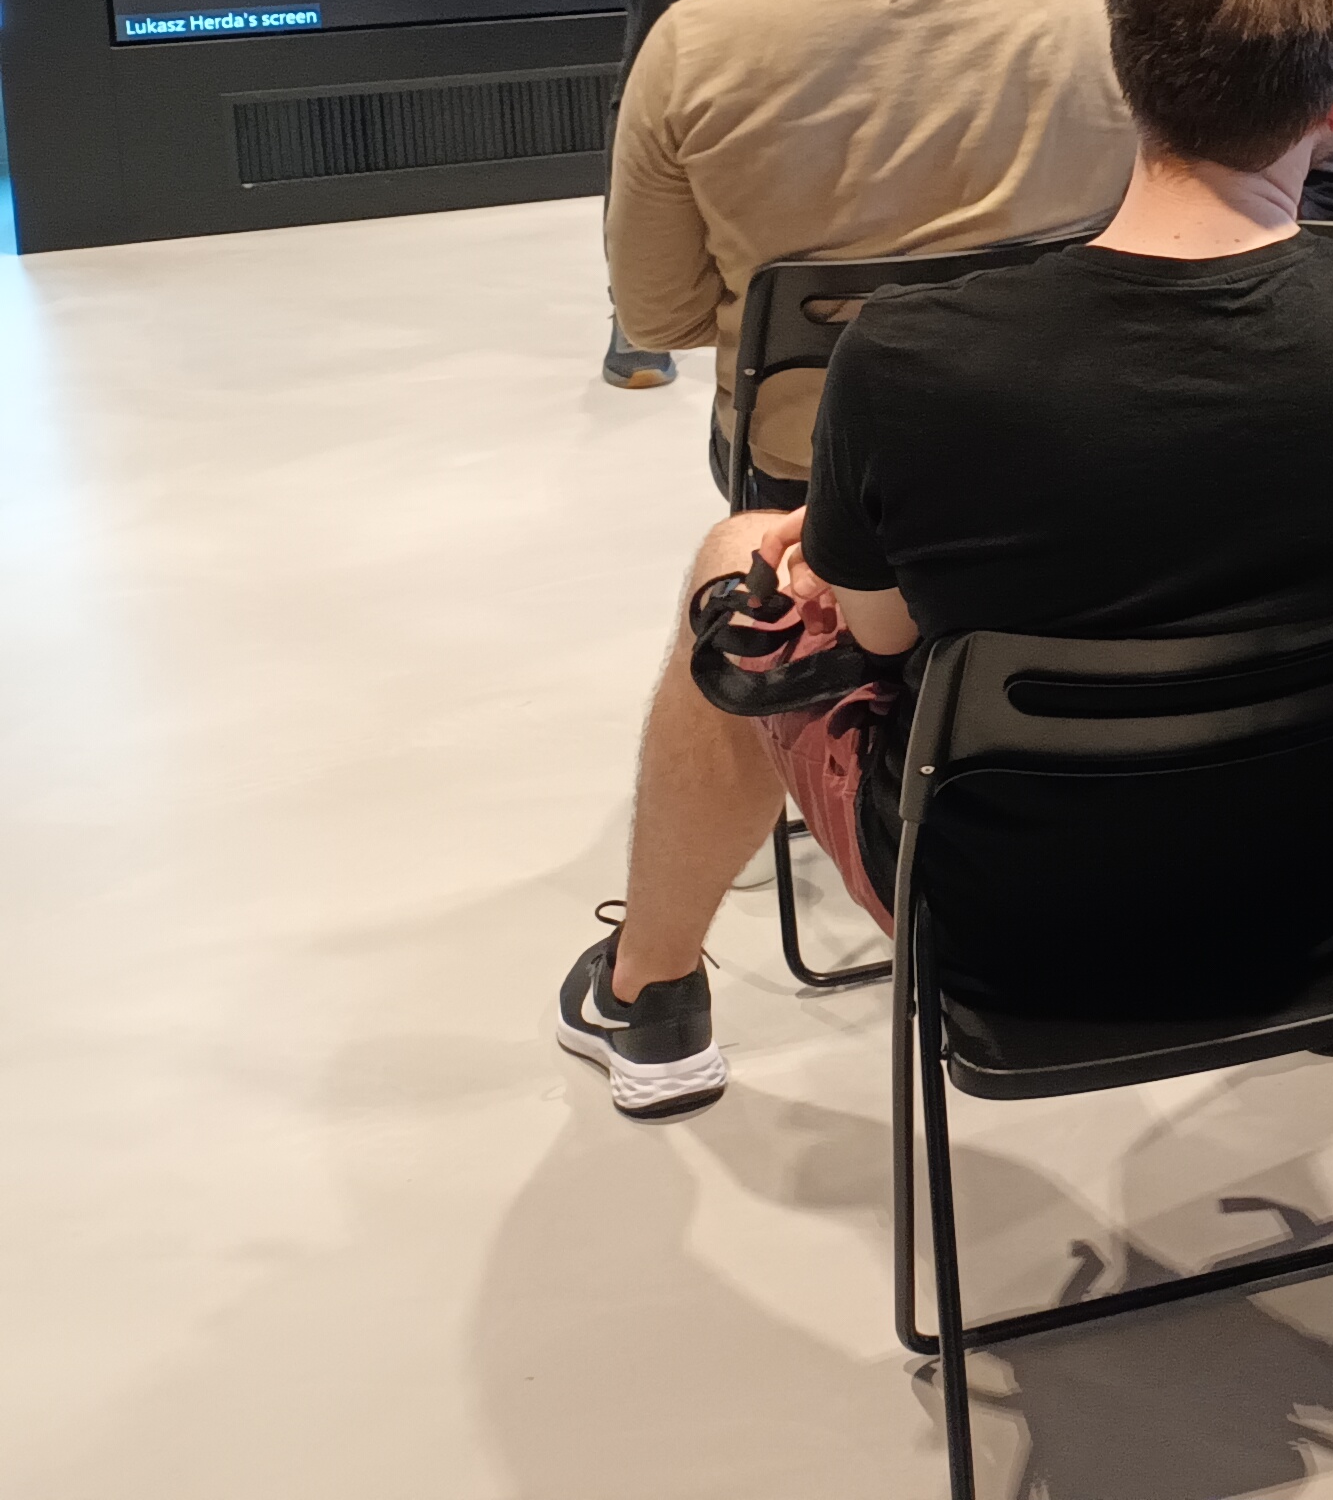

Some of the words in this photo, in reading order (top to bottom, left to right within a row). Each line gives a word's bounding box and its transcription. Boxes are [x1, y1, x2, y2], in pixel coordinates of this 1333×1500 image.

[125, 17, 187, 36] Lukasz
[189, 11, 258, 32] Herda's
[260, 10, 318, 27] screen
